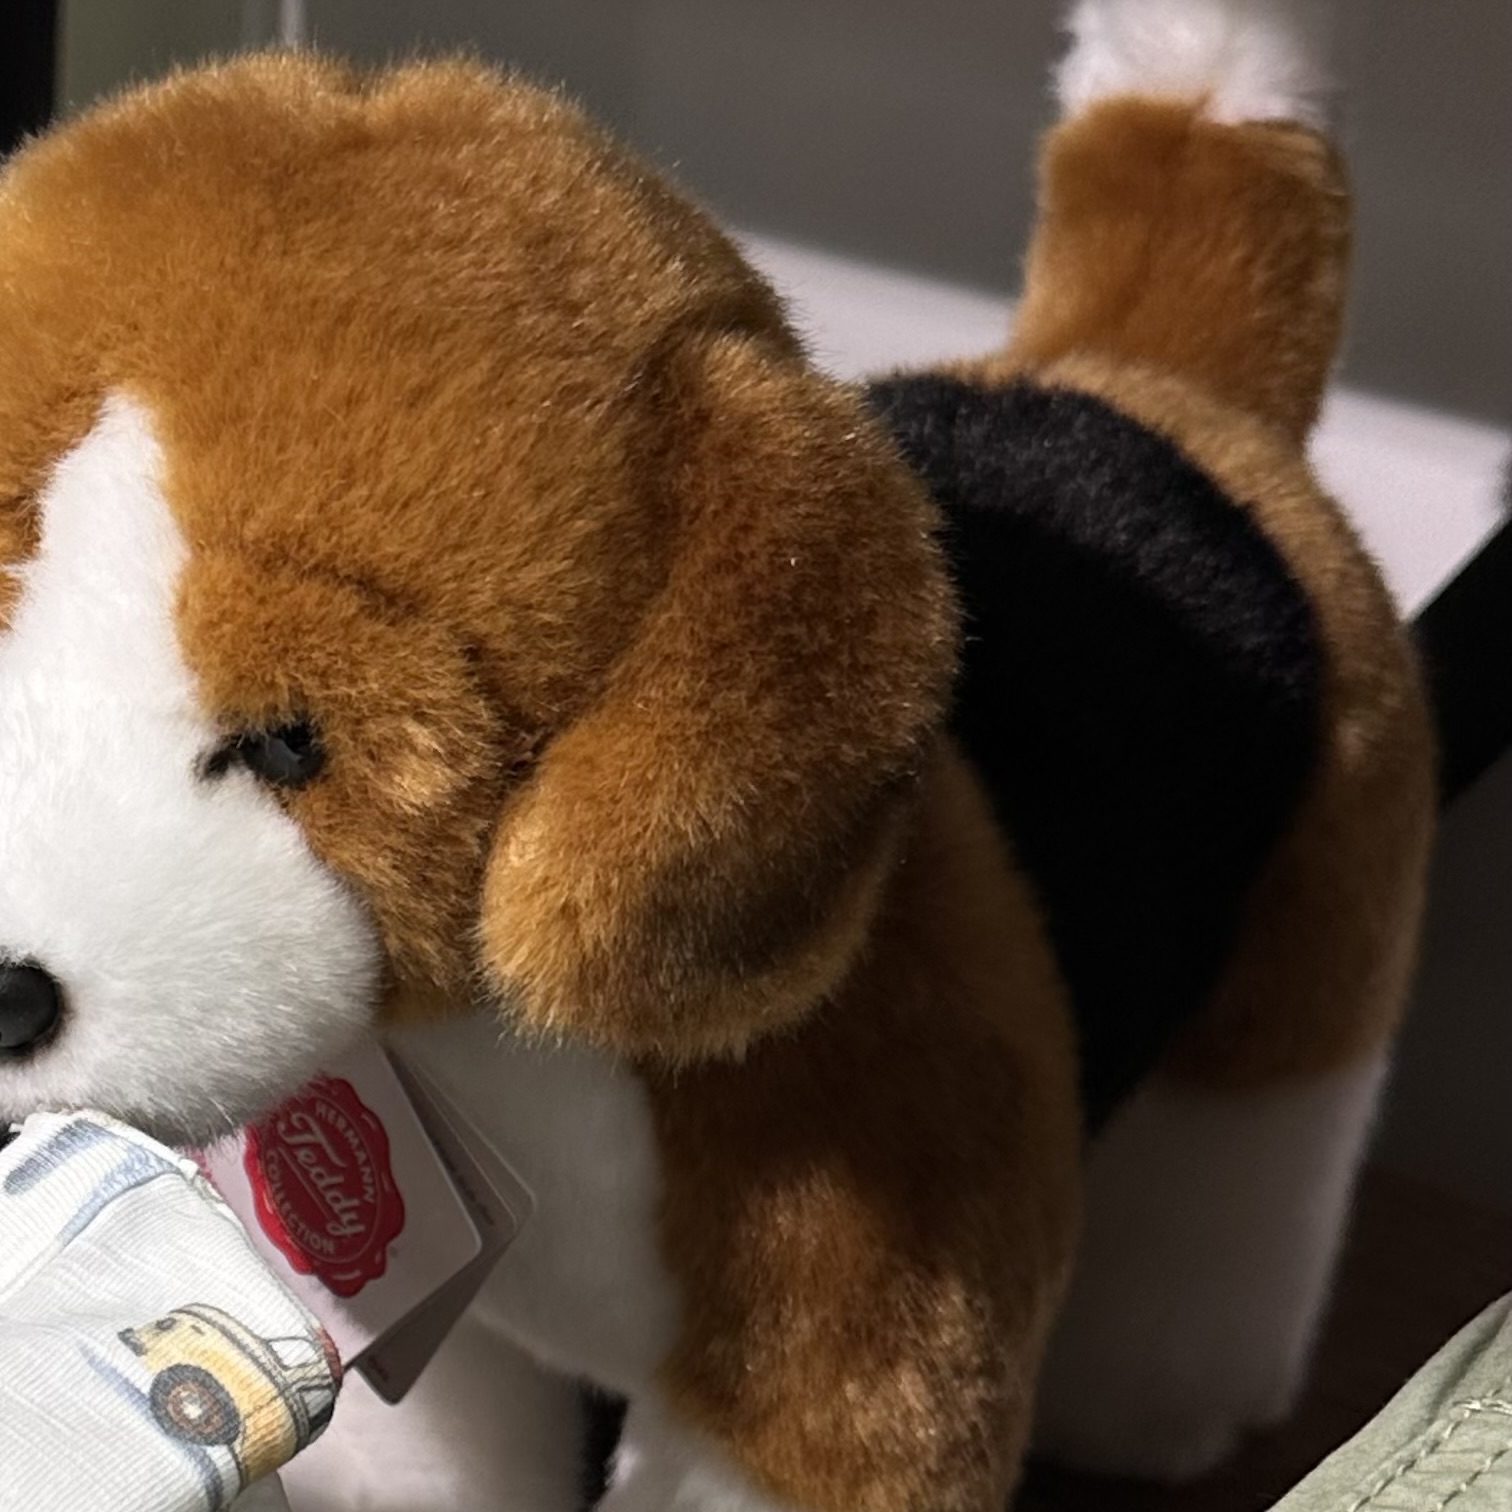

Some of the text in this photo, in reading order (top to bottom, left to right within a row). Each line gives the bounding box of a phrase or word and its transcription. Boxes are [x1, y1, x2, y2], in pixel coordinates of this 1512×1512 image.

[266, 1151, 336, 1256] COLLECTION
[276, 1110, 366, 1239] Teddy
[314, 1100, 377, 1205] HERMANN
